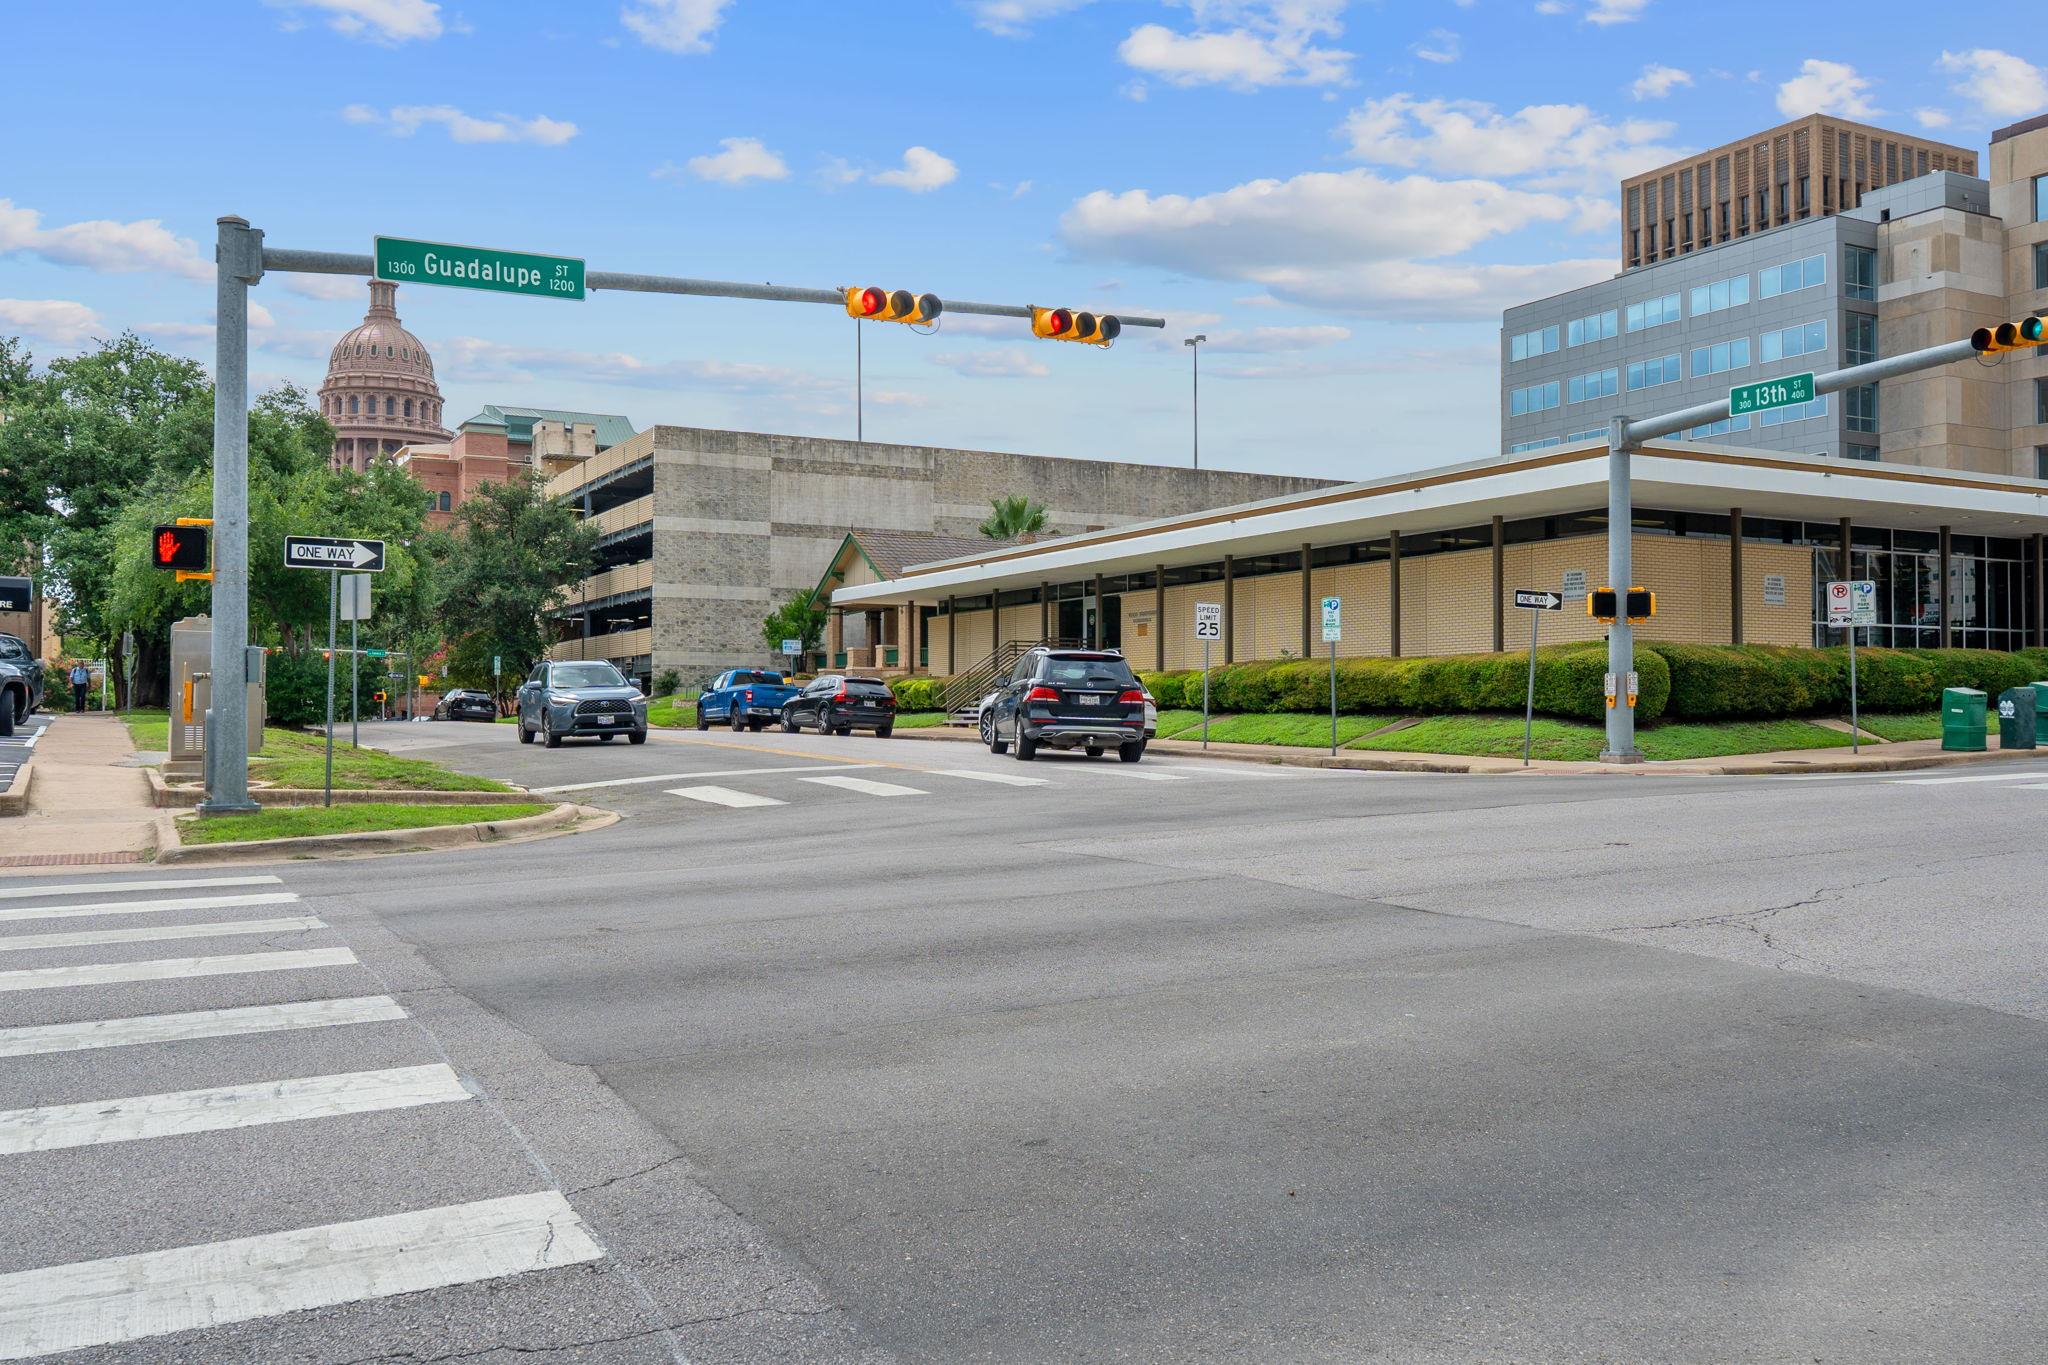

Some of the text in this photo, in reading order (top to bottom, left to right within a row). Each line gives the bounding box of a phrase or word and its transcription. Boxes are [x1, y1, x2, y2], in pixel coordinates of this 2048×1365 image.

[388, 253, 569, 287] 1300 Guadalupe ST
[550, 279, 575, 292] 1200
[1755, 384, 1787, 406] 13th
[1793, 380, 1802, 389] ST
[1791, 390, 1805, 399] 400
[1738, 400, 1751, 409] 300
[297, 546, 355, 560] ONE WAY
[1520, 595, 1548, 604] ONE WAY
[1198, 622, 1219, 636] 25
